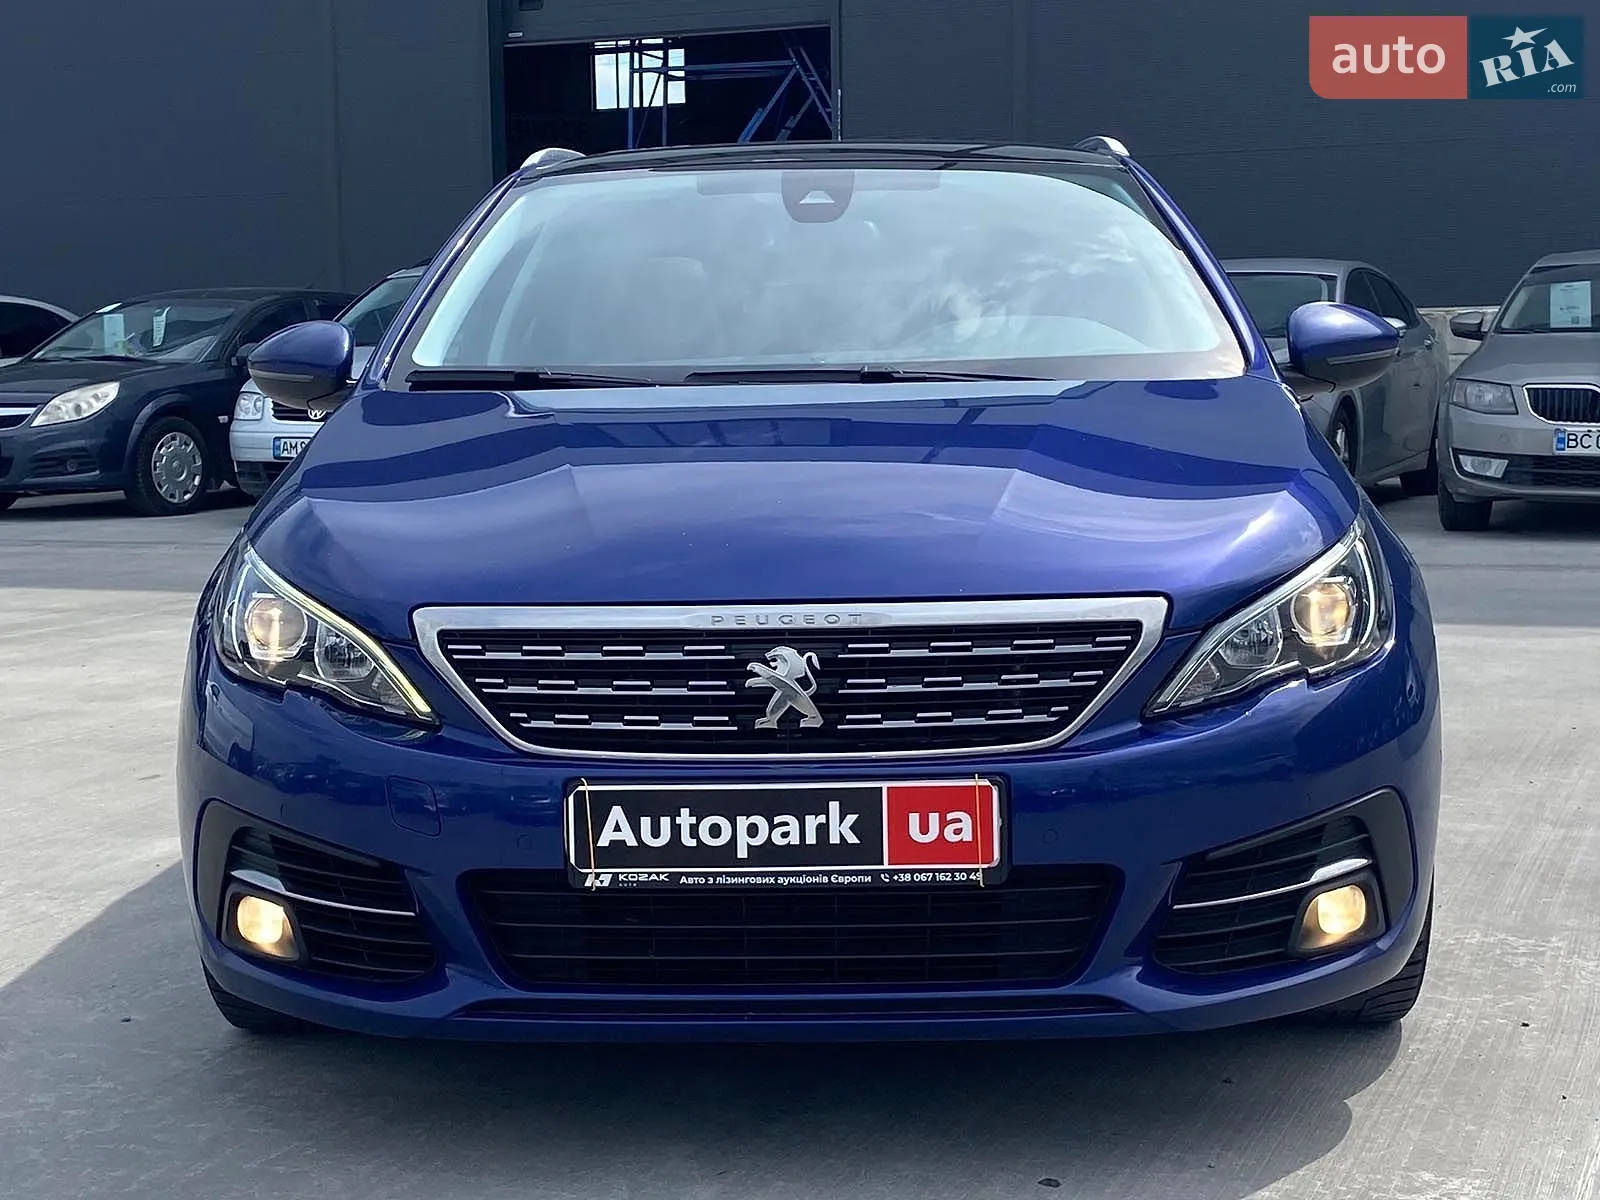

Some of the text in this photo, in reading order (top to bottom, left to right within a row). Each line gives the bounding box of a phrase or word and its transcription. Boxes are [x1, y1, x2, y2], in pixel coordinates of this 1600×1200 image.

[710, 613, 863, 626] PEUGEOT
[596, 800, 973, 859] Autopark ua
[618, 873, 670, 882] KOZAK
[679, 873, 872, 886] Авто з лізингових аукціонів Європи
[892, 872, 912, 882] +38
[913, 872, 934, 882] 067
[935, 871, 953, 881] 162
[953, 871, 968, 881] 30
